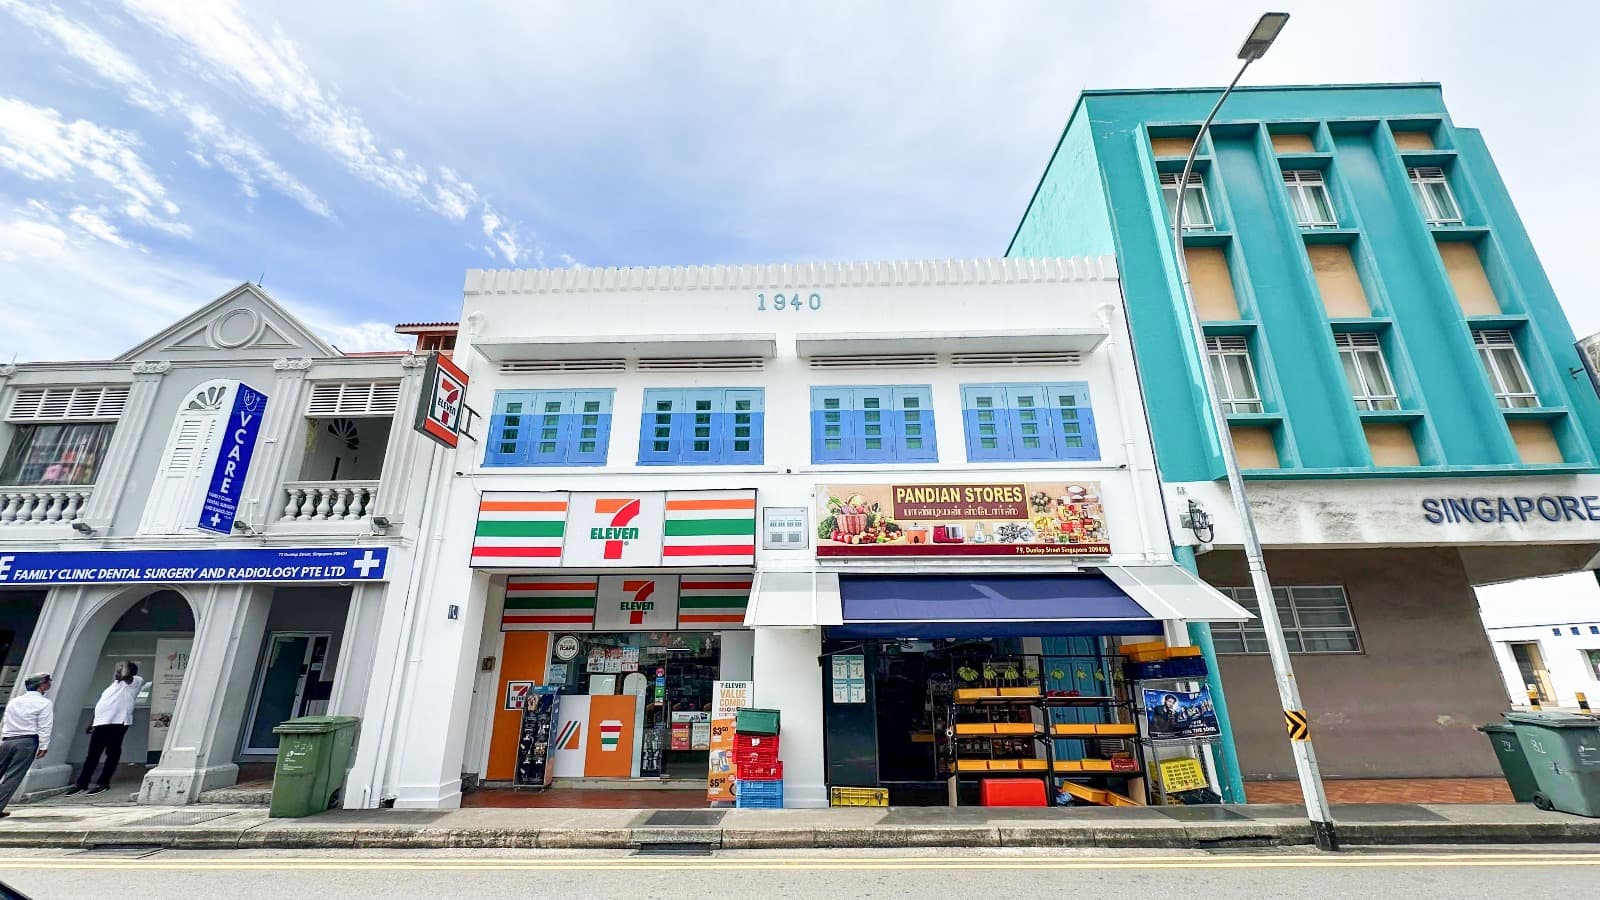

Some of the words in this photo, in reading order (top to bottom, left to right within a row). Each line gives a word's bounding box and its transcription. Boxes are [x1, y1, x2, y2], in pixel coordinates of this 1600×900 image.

[758, 293, 821, 311] 1940
[441, 378, 460, 426] 7
[220, 410, 252, 494] VCARE
[896, 487, 960, 503] PANDIAN
[965, 487, 1022, 502] STORES
[1422, 495, 1600, 523] SINGAPORE
[595, 498, 641, 559] 7
[13, 569, 57, 580] FAMILY
[58, 568, 96, 580] CLINIC
[98, 568, 140, 579] DENTAL
[143, 568, 197, 579] SURGERY
[200, 567, 226, 579] AND
[227, 566, 299, 578] RADIOLOGY
[301, 566, 322, 577] PTE
[324, 566, 346, 577] LTD
[623, 580, 655, 625] 7
[719, 698, 746, 707] COMBO
[720, 689, 747, 698] VALUE
